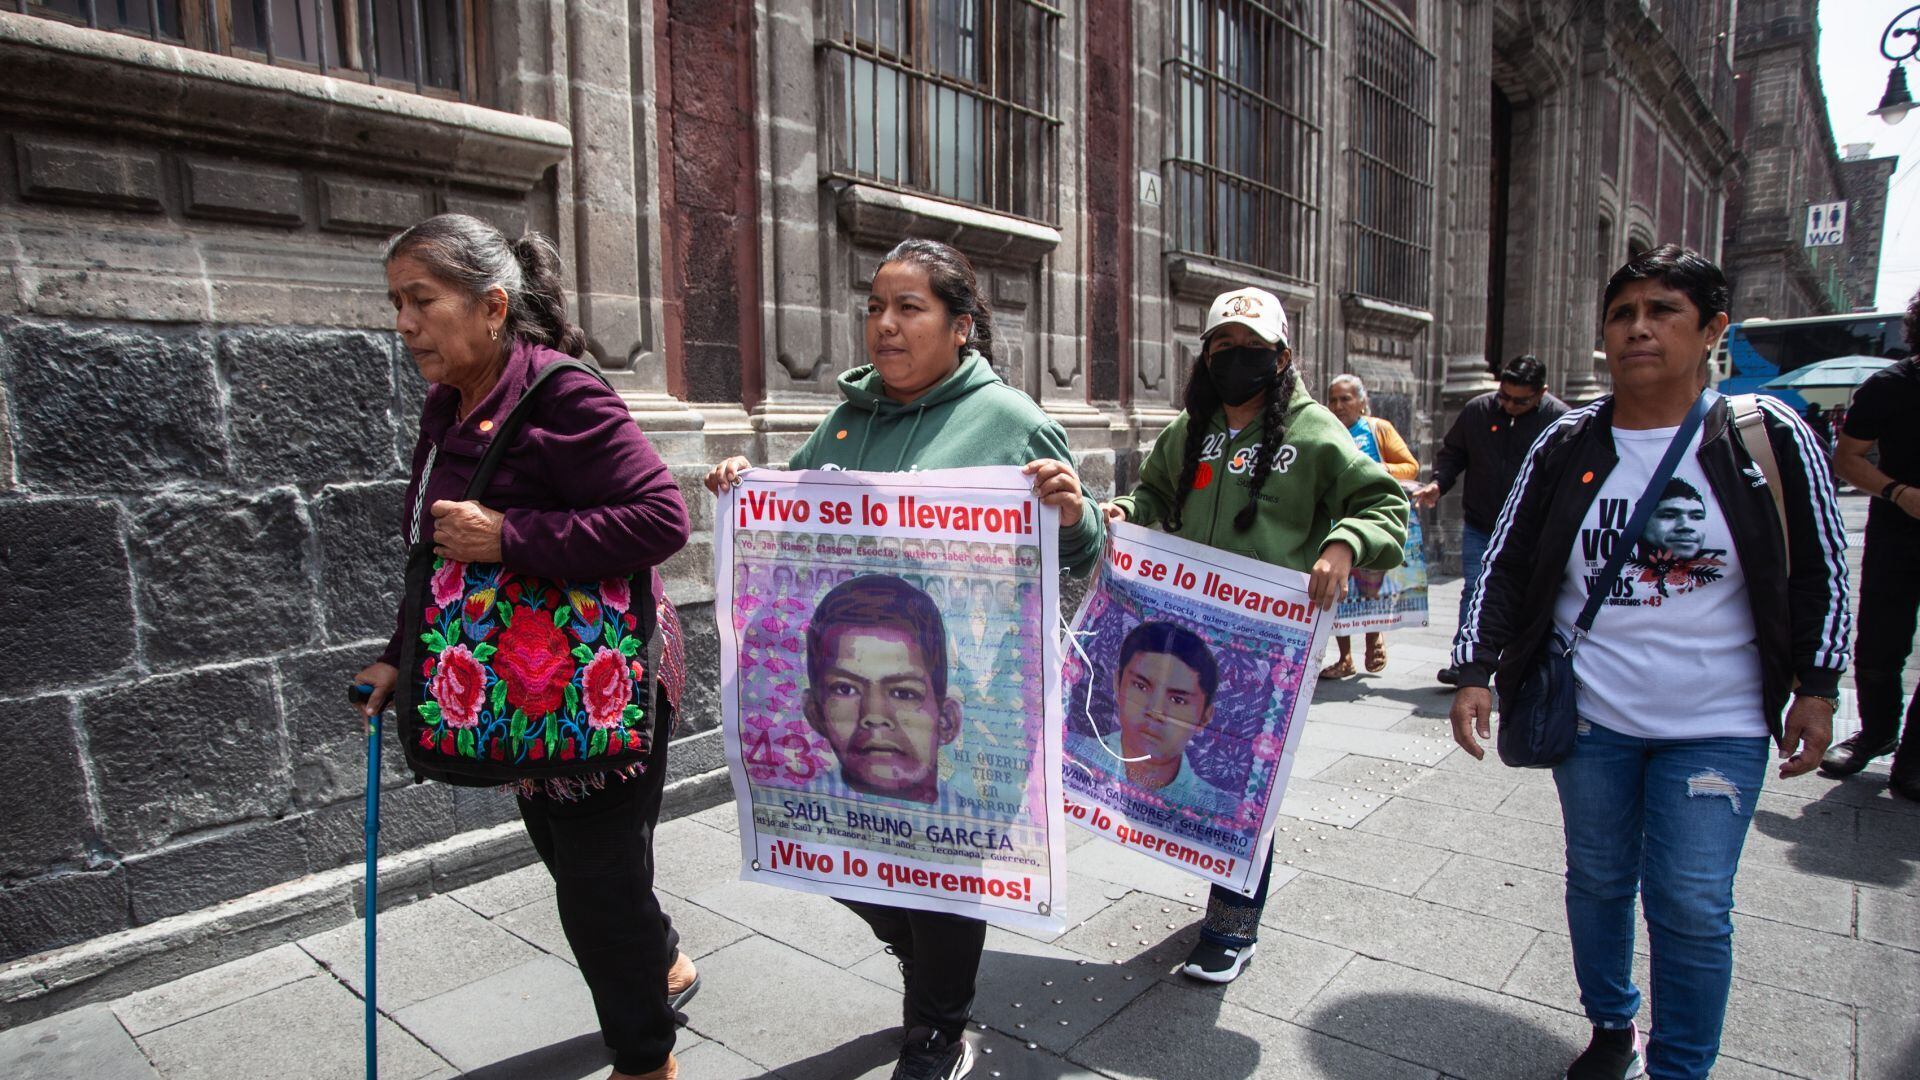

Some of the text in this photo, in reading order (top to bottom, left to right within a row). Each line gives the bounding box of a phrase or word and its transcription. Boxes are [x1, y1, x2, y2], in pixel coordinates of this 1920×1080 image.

[1145, 177, 1157, 202] A
[1809, 230, 1841, 245] WC
[739, 490, 1033, 534] ¡Vivo se lo llevaron!
[1599, 499, 1628, 529] VI
[742, 540, 756, 550] Yo,
[762, 541, 776, 551] Jan
[904, 550, 938, 562] quiero
[942, 551, 969, 563] saber
[1138, 559, 1167, 581] se
[1173, 563, 1197, 590] lo
[1203, 572, 1316, 624] llevaron!
[1202, 614, 1229, 627] quiero
[1232, 622, 1256, 633] saber
[747, 730, 816, 779] 43
[784, 801, 1014, 851] SAÚL BRUNO GARCÍA
[1091, 806, 1111, 830] lo
[1117, 824, 1235, 878] queremos!
[1181, 819, 1247, 847] GUERRERO
[816, 827, 823, 835] y
[990, 853, 1040, 867] Guerrero,
[770, 840, 1031, 901] ¡Vivo lo queremos!
